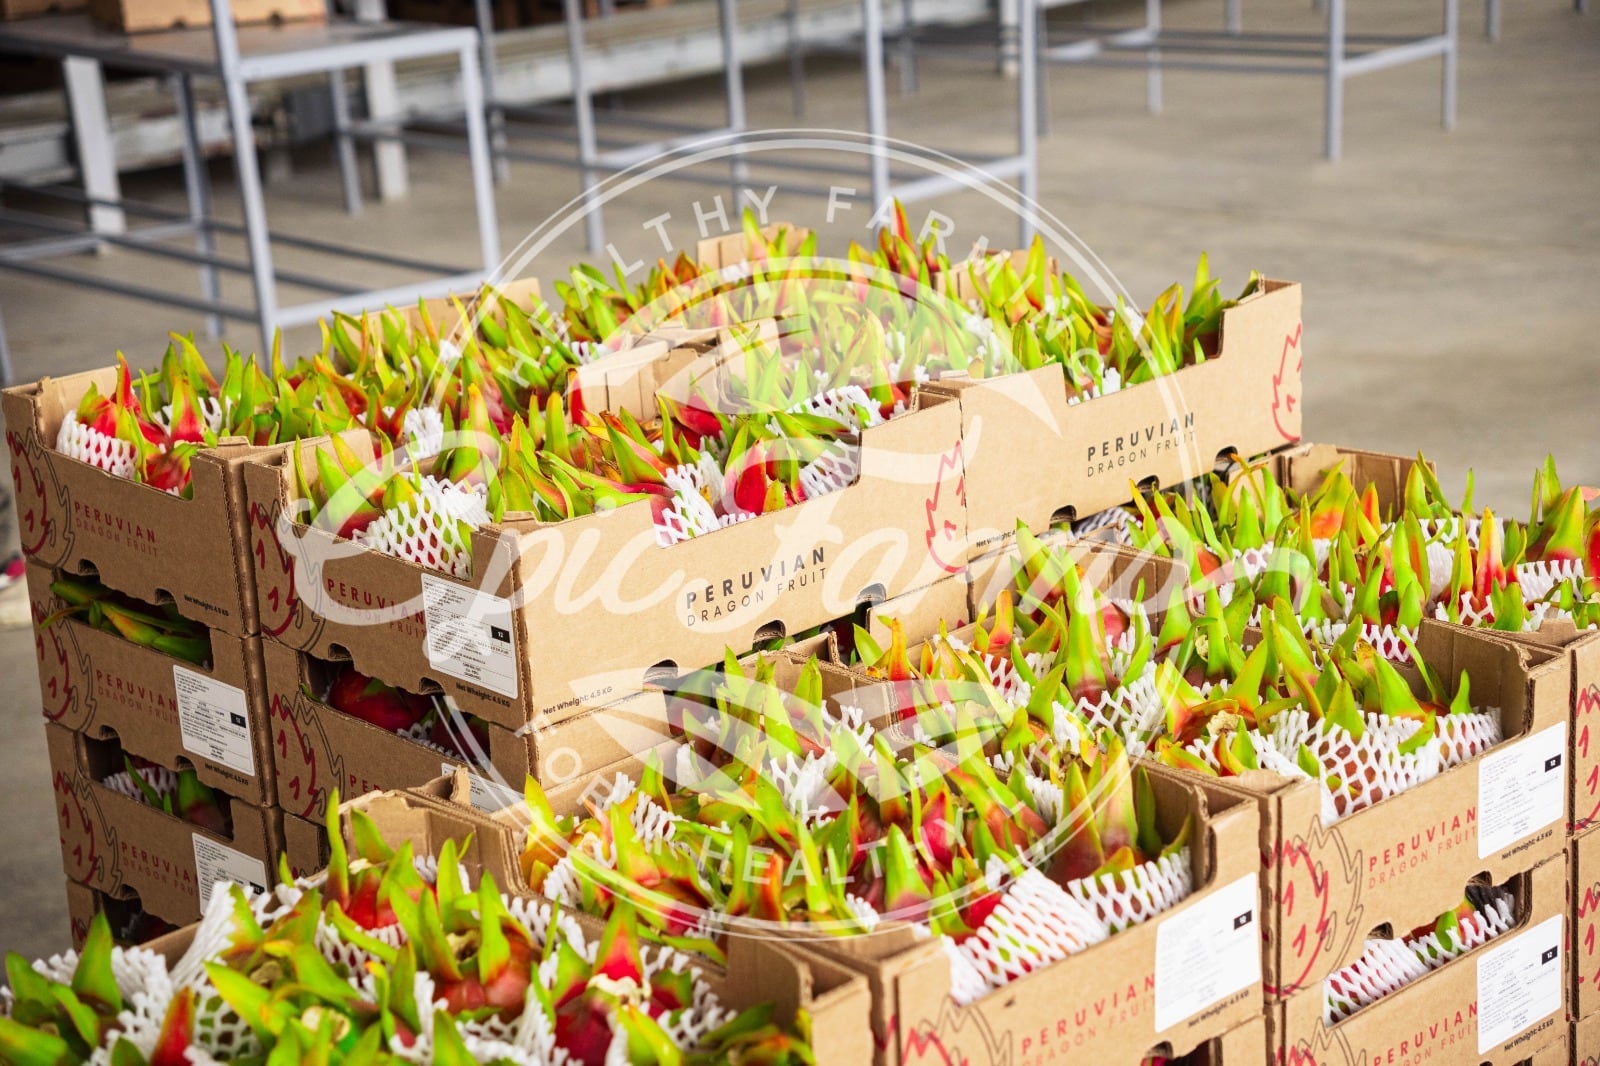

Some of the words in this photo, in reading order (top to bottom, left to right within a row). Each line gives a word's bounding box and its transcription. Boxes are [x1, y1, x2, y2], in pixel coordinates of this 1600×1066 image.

[1087, 412, 1195, 462] PERUVIAN
[1087, 447, 1147, 478] DRAGON
[1156, 431, 1195, 456] FRUIT
[74, 501, 156, 543] PERUVIAN
[75, 517, 120, 543] DRAGON
[126, 537, 159, 559] FRUIT
[327, 578, 426, 625] PERUVIAN
[686, 547, 825, 610] PERUVIAN
[687, 589, 765, 628] DRAGON
[777, 567, 827, 596] FRUIT
[390, 621, 428, 640] FRUIT
[95, 669, 177, 713] PERUVIAN
[97, 685, 143, 712] DRAGON
[542, 705, 557, 716] Net
[590, 688, 602, 700] 4.5
[602, 685, 614, 697] KG
[1368, 850, 1429, 889] DRAGON
[1438, 825, 1477, 855] FRUIT
[1369, 807, 1476, 872] PERUVIAN
[1022, 972, 1155, 1056] PERUVIAN
[1373, 1001, 1478, 1066] PERUVIAN
